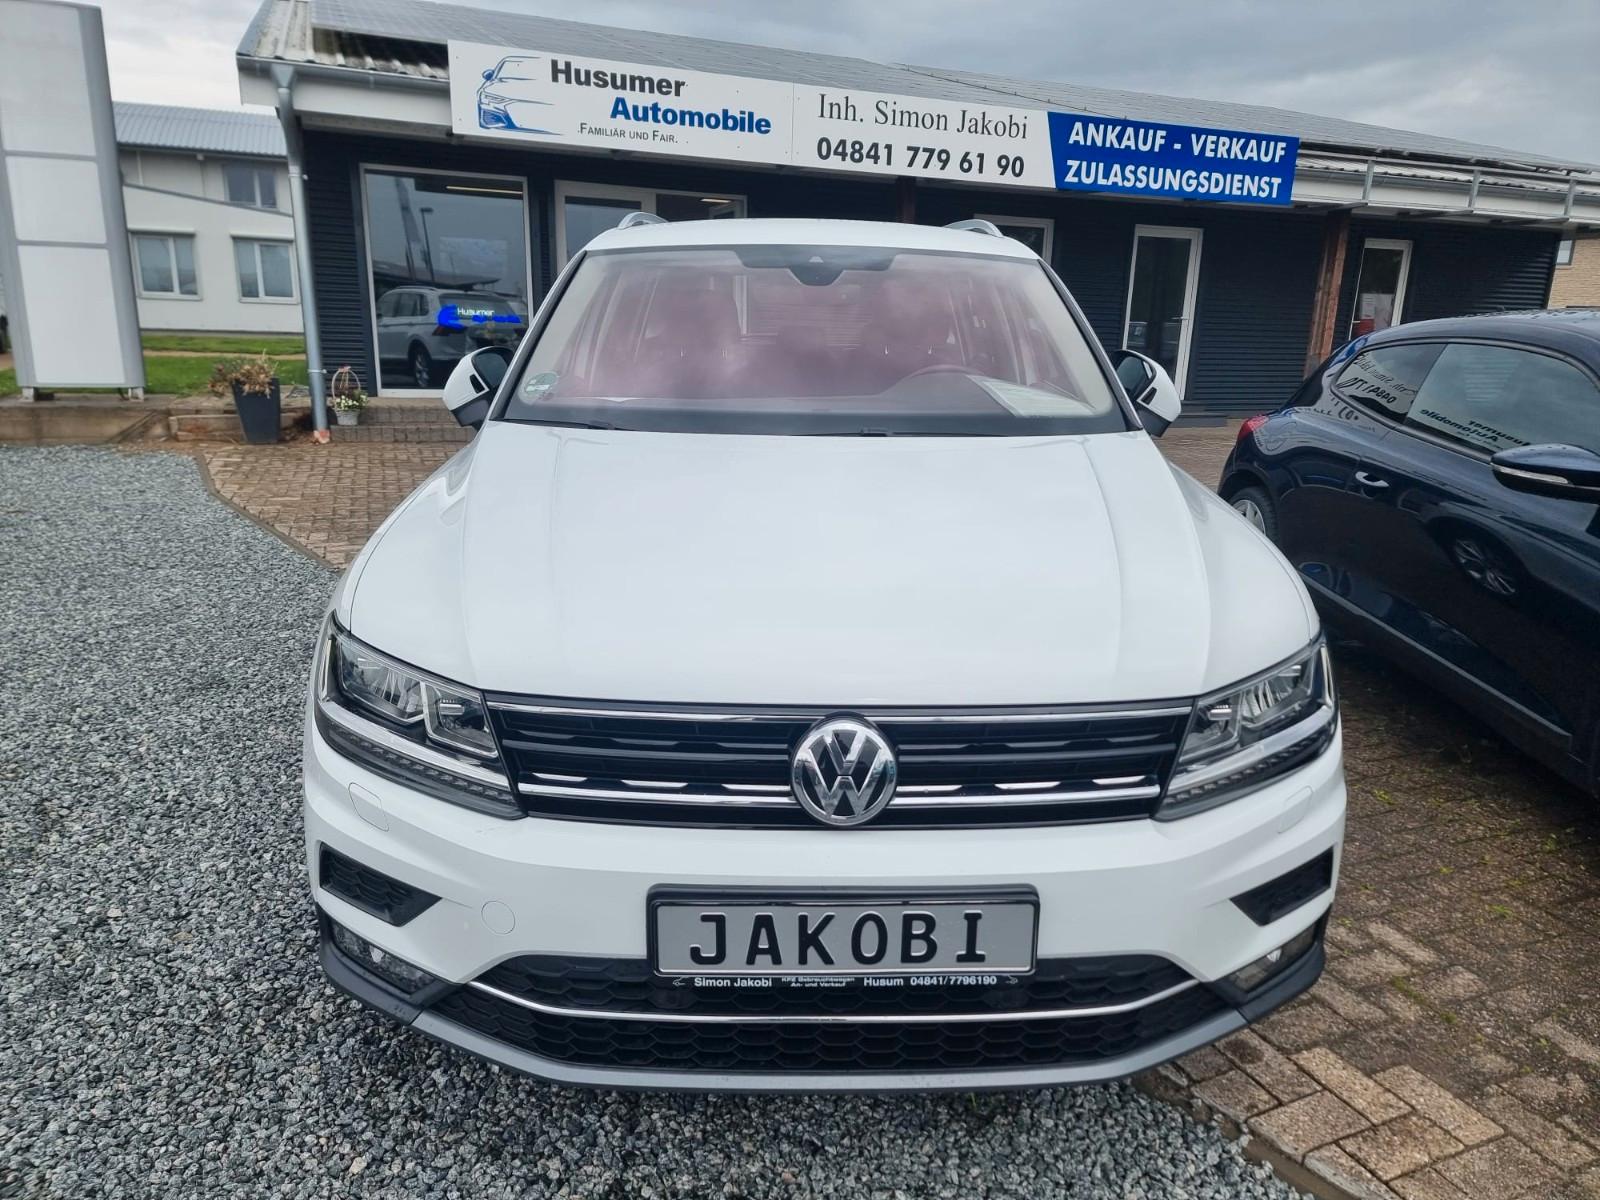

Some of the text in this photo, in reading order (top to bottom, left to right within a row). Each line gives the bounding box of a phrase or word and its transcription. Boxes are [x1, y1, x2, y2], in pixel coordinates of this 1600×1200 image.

[550, 59, 685, 97] Husumer
[610, 96, 772, 134] Automobile
[818, 93, 1028, 139] Inh. Simon Jakobi
[817, 137, 1025, 177] 04841 779 61 90
[1068, 121, 1167, 152] ANKAUF
[1191, 133, 1287, 163] VERKAUF
[1064, 160, 1282, 199] ZULASSUNGSDIENST
[689, 911, 987, 965] JAKOBI
[694, 977, 772, 987] Simon Jakobi
[863, 975, 997, 987] Husum 04841/7796190
